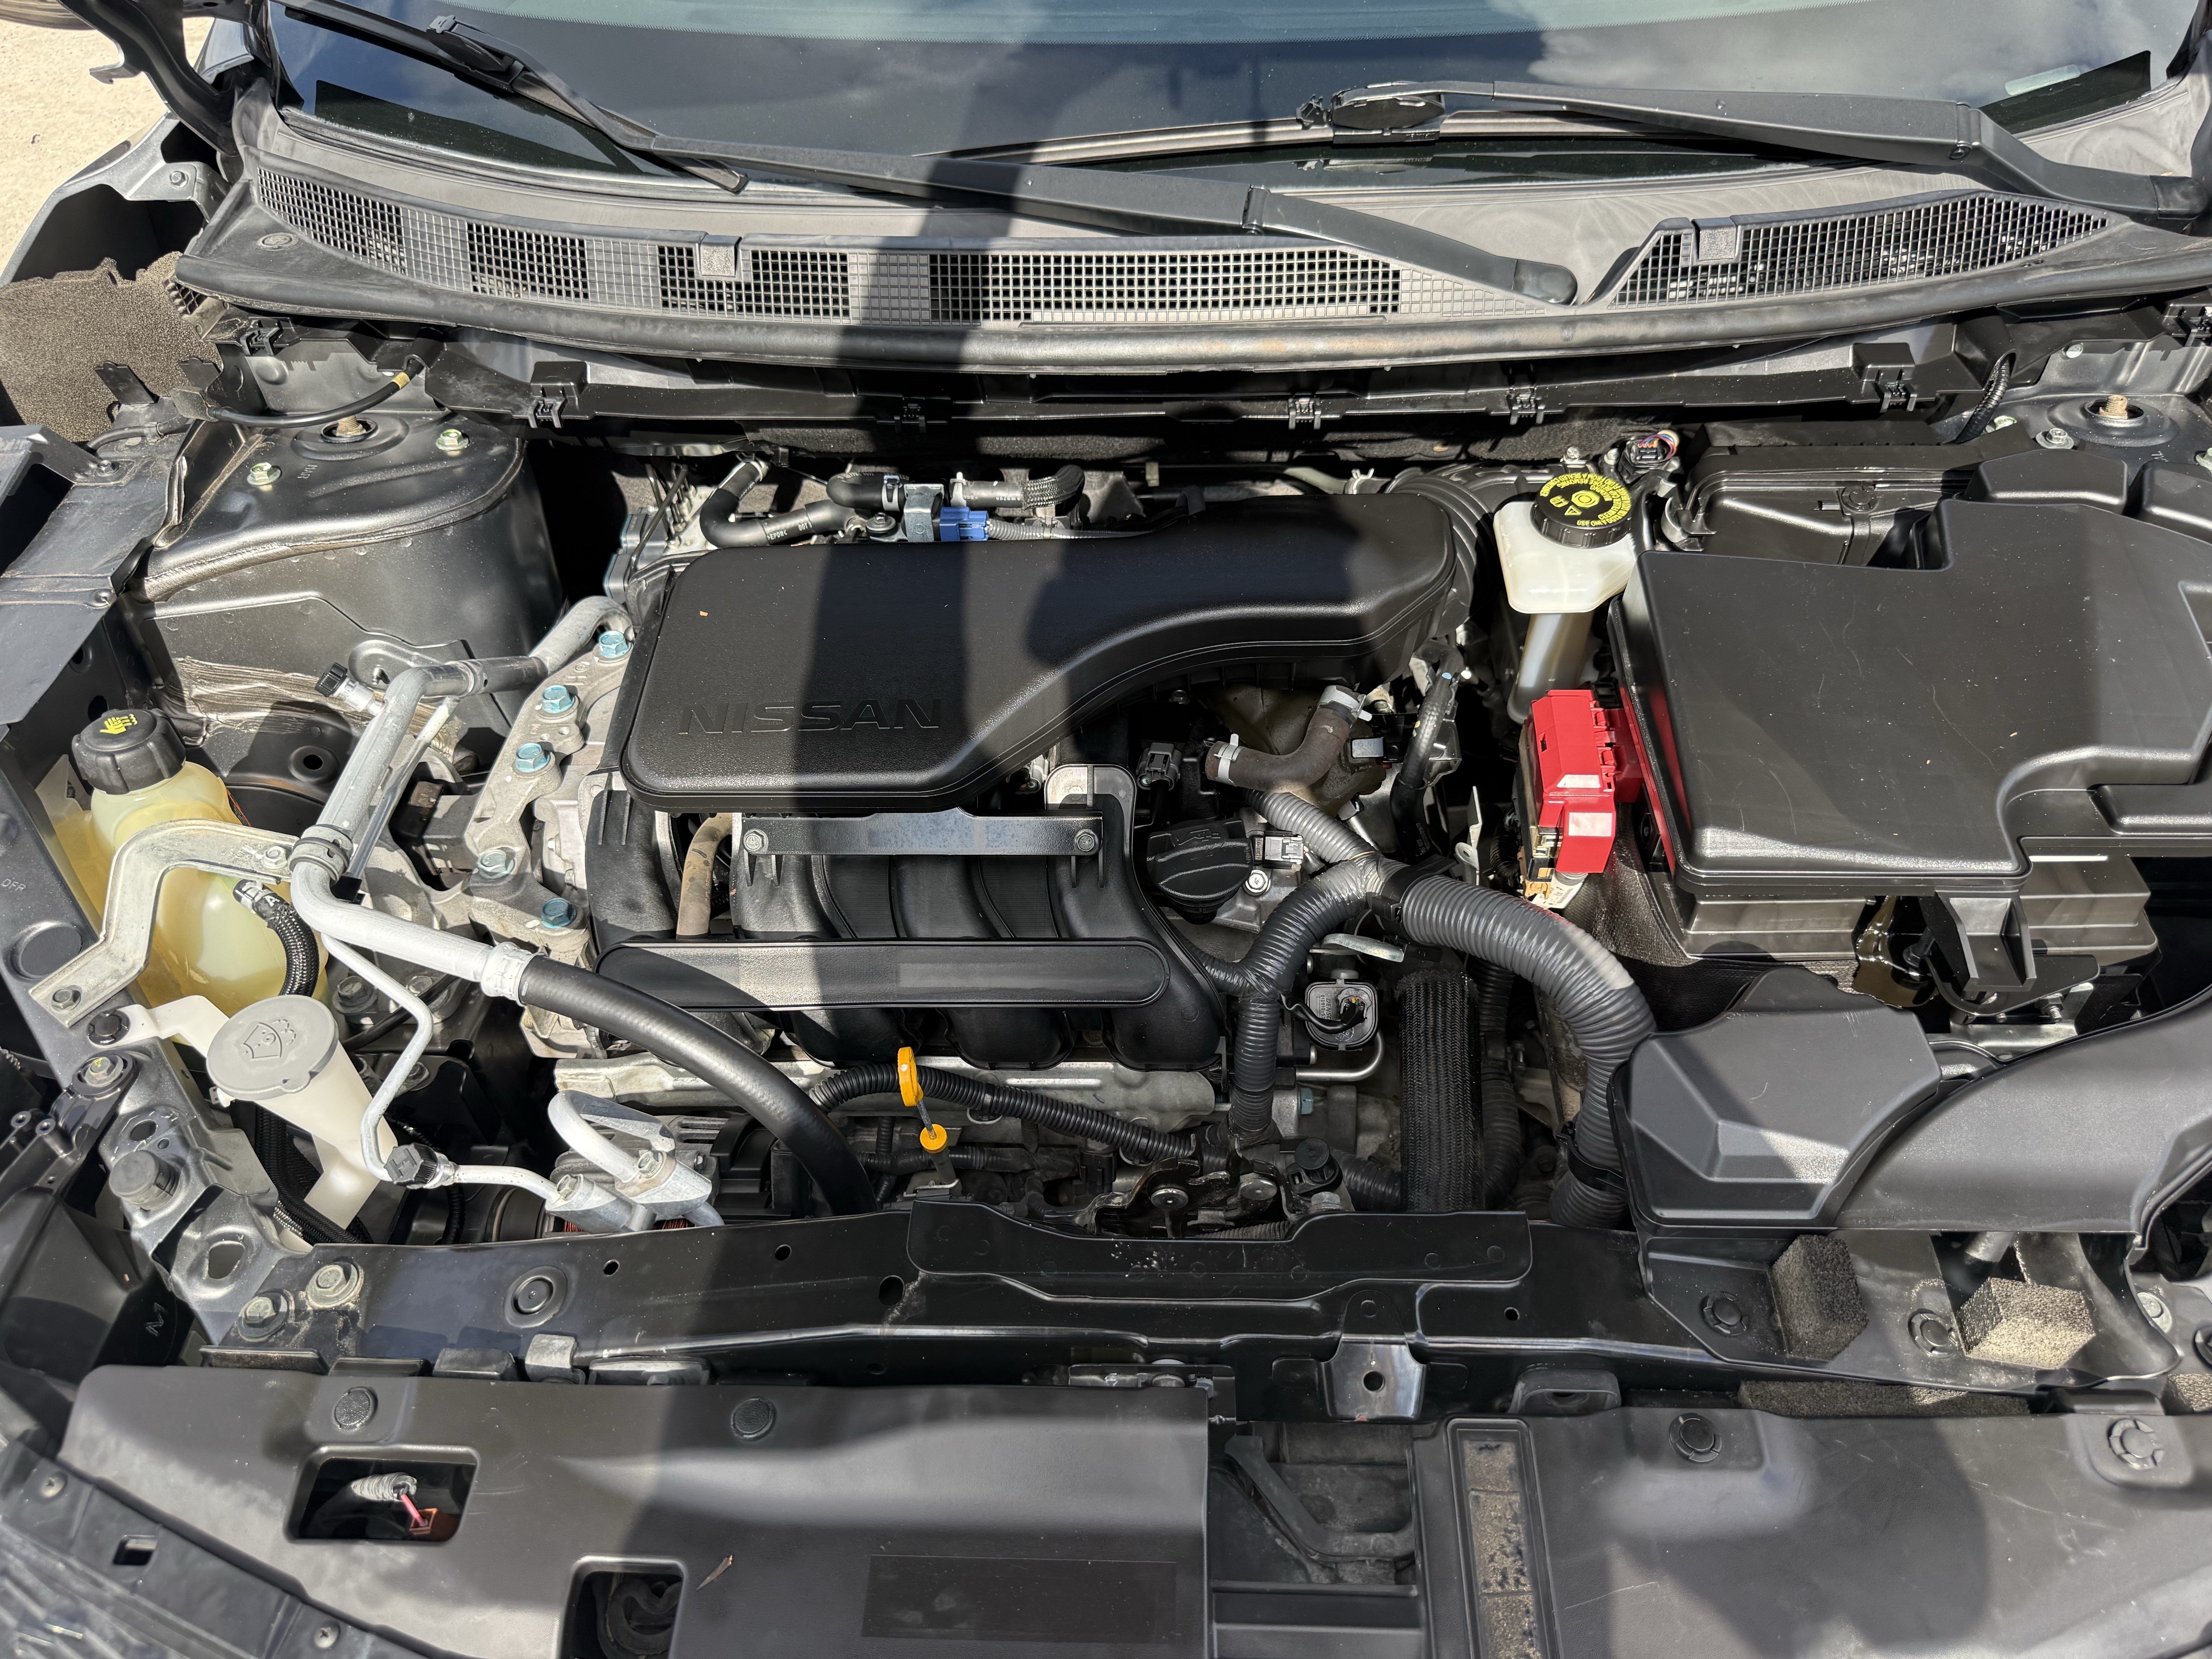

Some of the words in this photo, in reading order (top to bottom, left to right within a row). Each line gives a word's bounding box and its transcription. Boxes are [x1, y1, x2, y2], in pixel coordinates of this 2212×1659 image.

[1558, 473, 1582, 481] SEALED
[1587, 474, 1607, 483] FROM
[1556, 479, 1589, 488] REMOVING
[1589, 479, 1614, 491] BEFORE
[1590, 485, 1612, 501] WARNING
[1608, 490, 1620, 498] CAP
[1616, 488, 1630, 500] BRAKE
[678, 699, 943, 735] NISSAN
